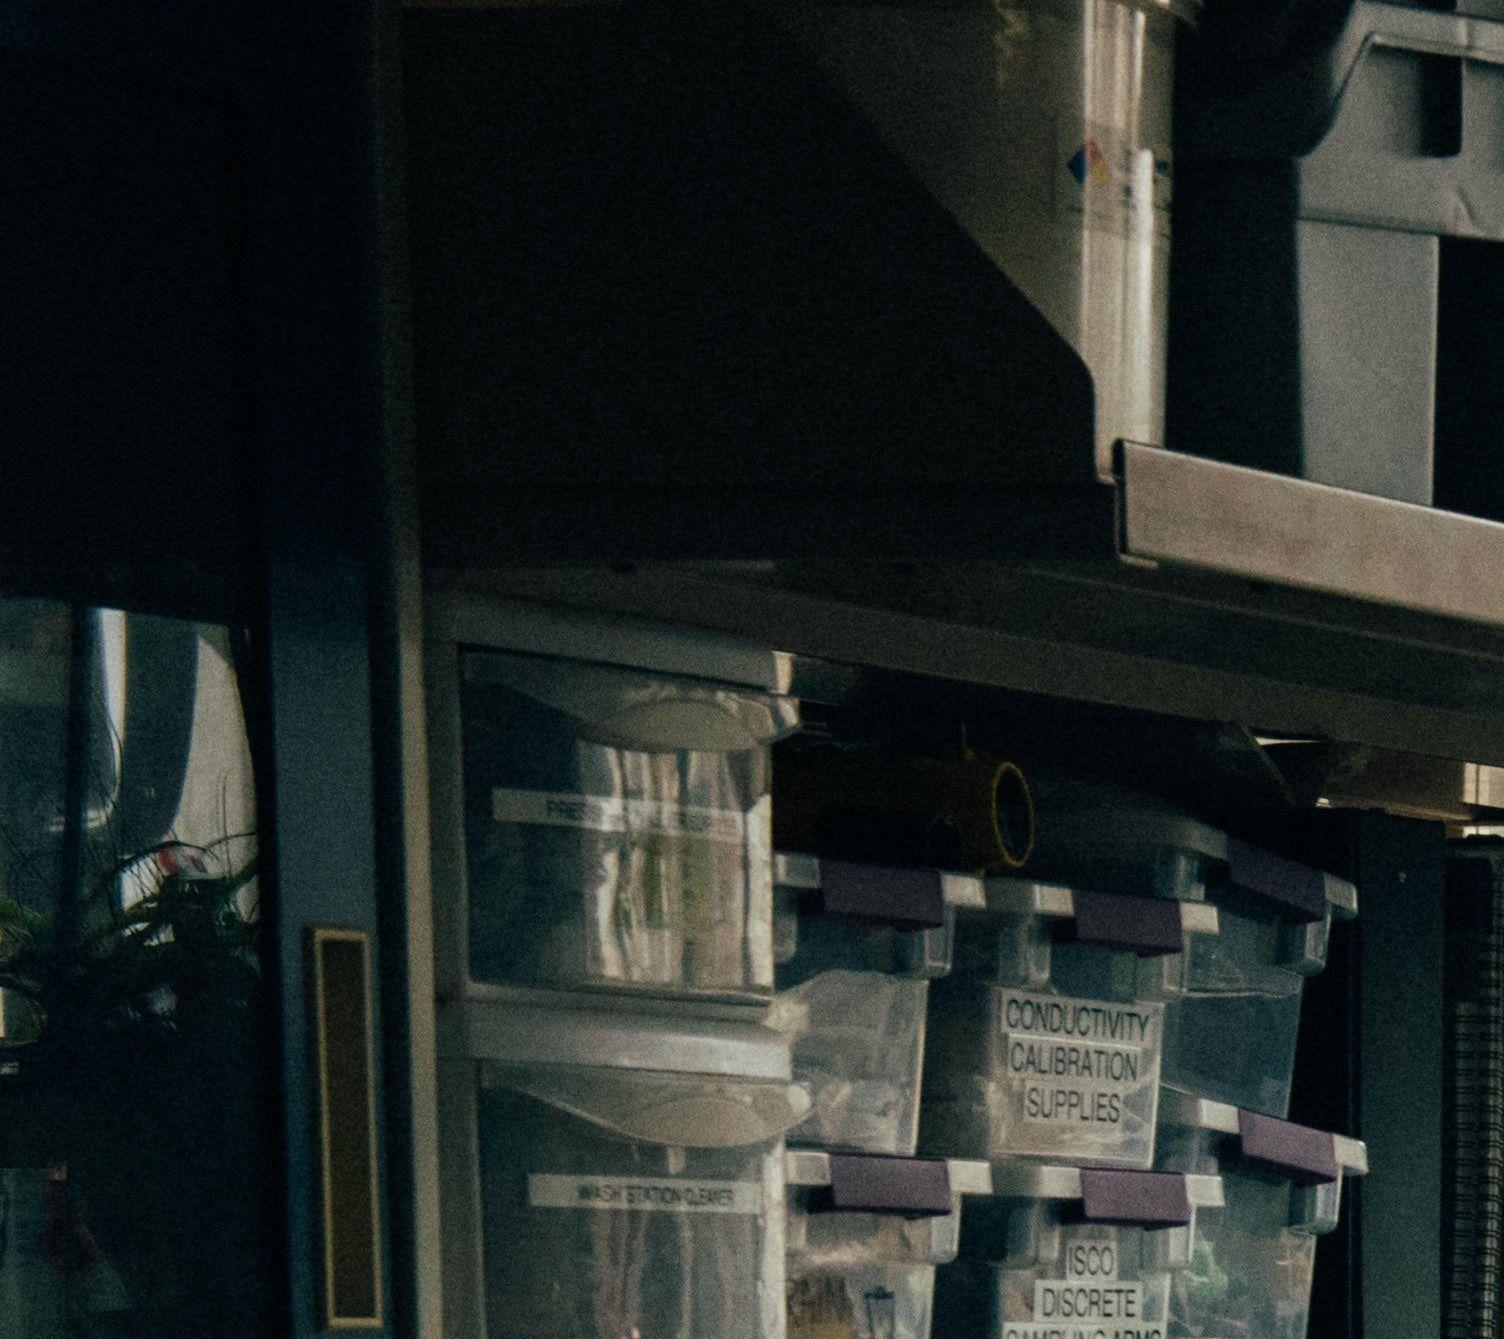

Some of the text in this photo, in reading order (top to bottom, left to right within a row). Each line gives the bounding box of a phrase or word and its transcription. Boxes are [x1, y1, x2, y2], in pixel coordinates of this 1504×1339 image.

[1006, 999, 1149, 1042] CONDUCTIVITY
[1010, 1042, 1138, 1081] CALIBRATION
[1027, 1087, 1121, 1123] SUPPLIES
[1067, 1245, 1115, 1276] ISCO
[1042, 1287, 1137, 1318] DISCRETE
